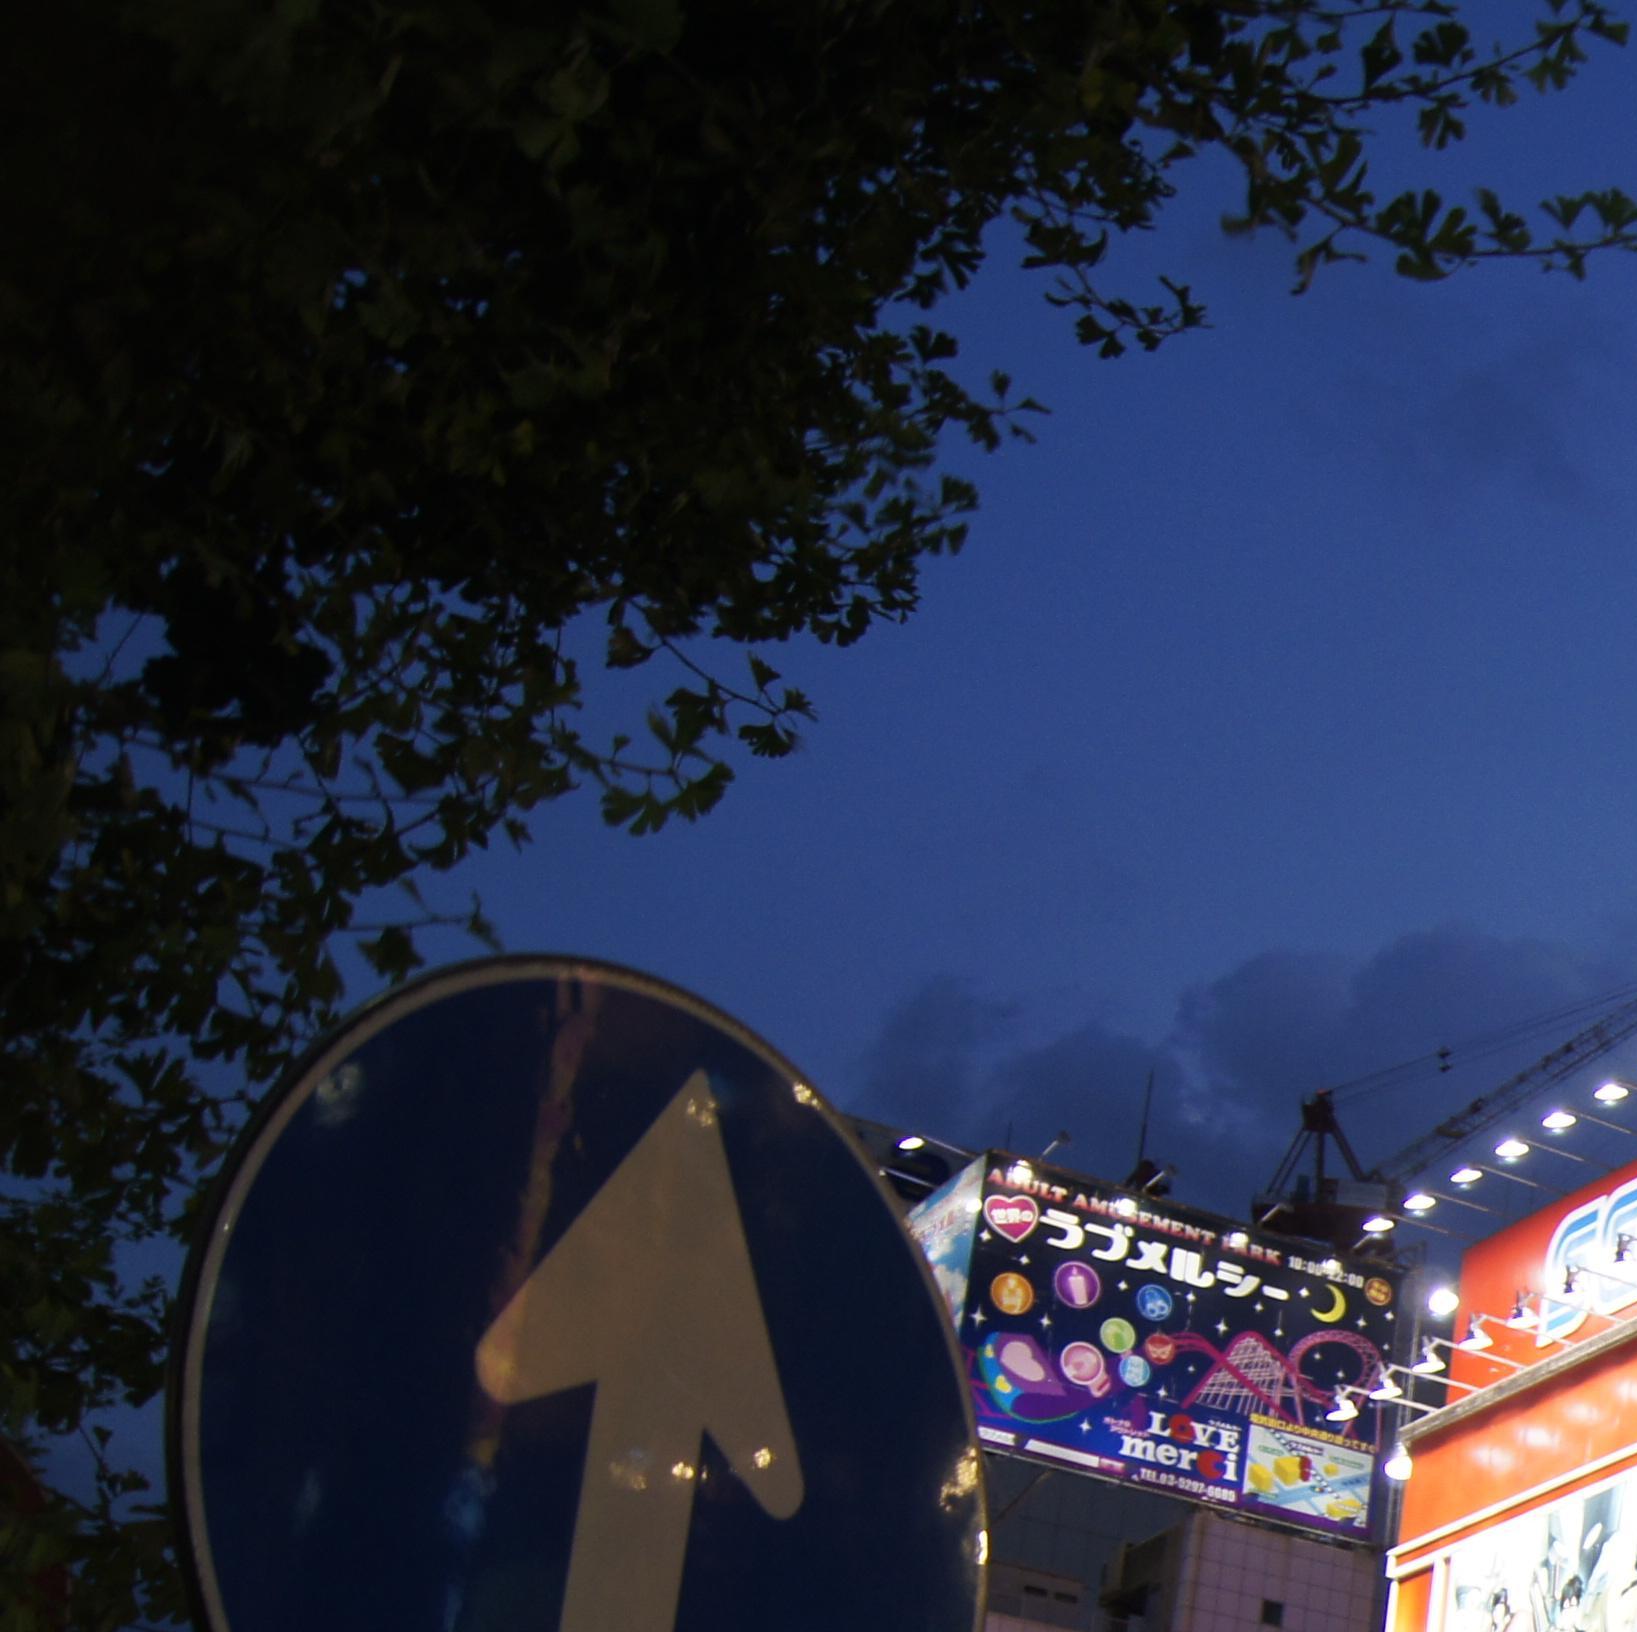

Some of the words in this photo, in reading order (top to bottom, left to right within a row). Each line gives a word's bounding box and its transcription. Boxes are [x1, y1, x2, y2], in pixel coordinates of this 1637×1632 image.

[1040, 1208, 1290, 1302] ラブメルシー
[1148, 1411, 1241, 1453] LOVE
